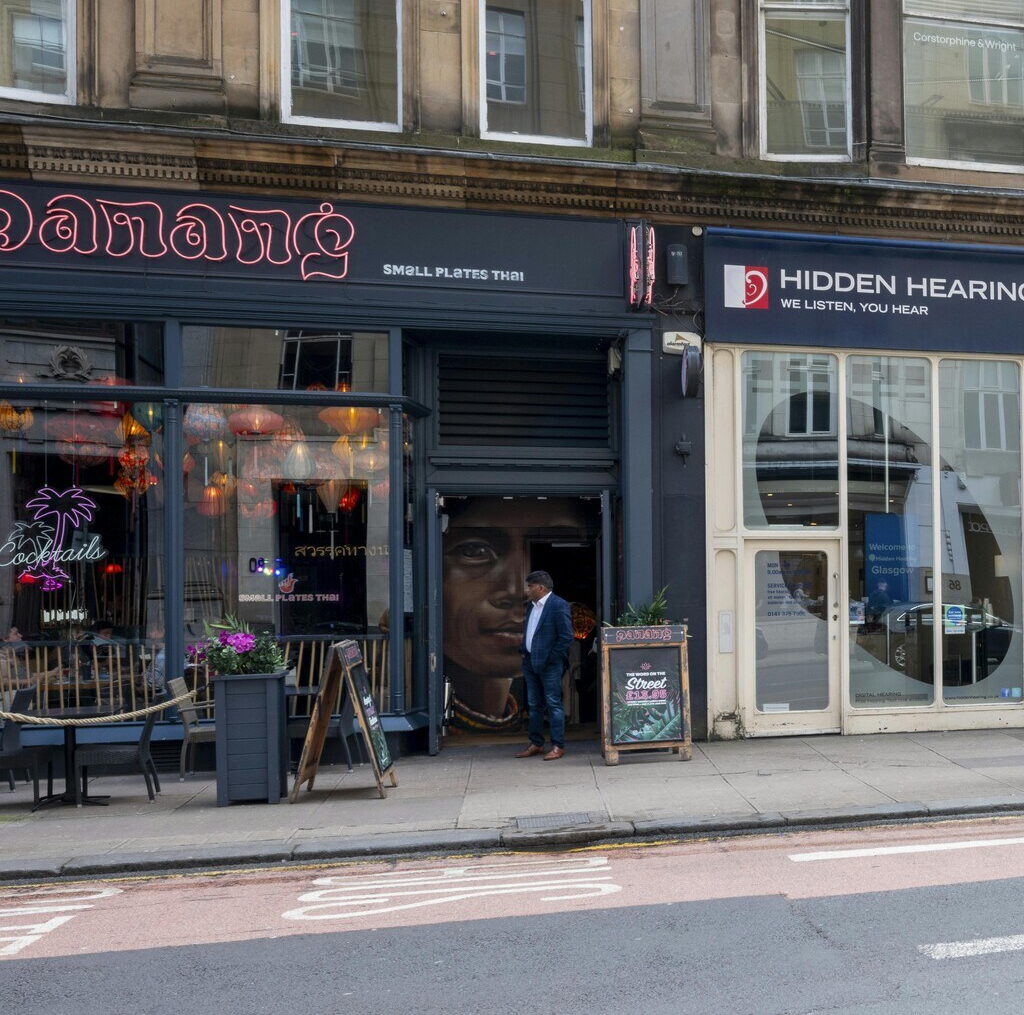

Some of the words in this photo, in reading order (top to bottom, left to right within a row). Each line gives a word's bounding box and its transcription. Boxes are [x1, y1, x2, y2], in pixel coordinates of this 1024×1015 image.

[913, 32, 976, 46] Corstorphine
[977, 39, 984, 48] &
[985, 40, 1017, 53] Wright
[780, 269, 896, 295] HIDDEN
[781, 299, 801, 308] WE
[804, 300, 857, 313] LISTEN,
[859, 302, 888, 313] YOU
[892, 305, 929, 315] HEAR
[0, 535, 105, 566] Cocktails
[869, 543, 905, 551] Welcome
[871, 565, 914, 576] Glasgow
[625, 677, 667, 690] Street
